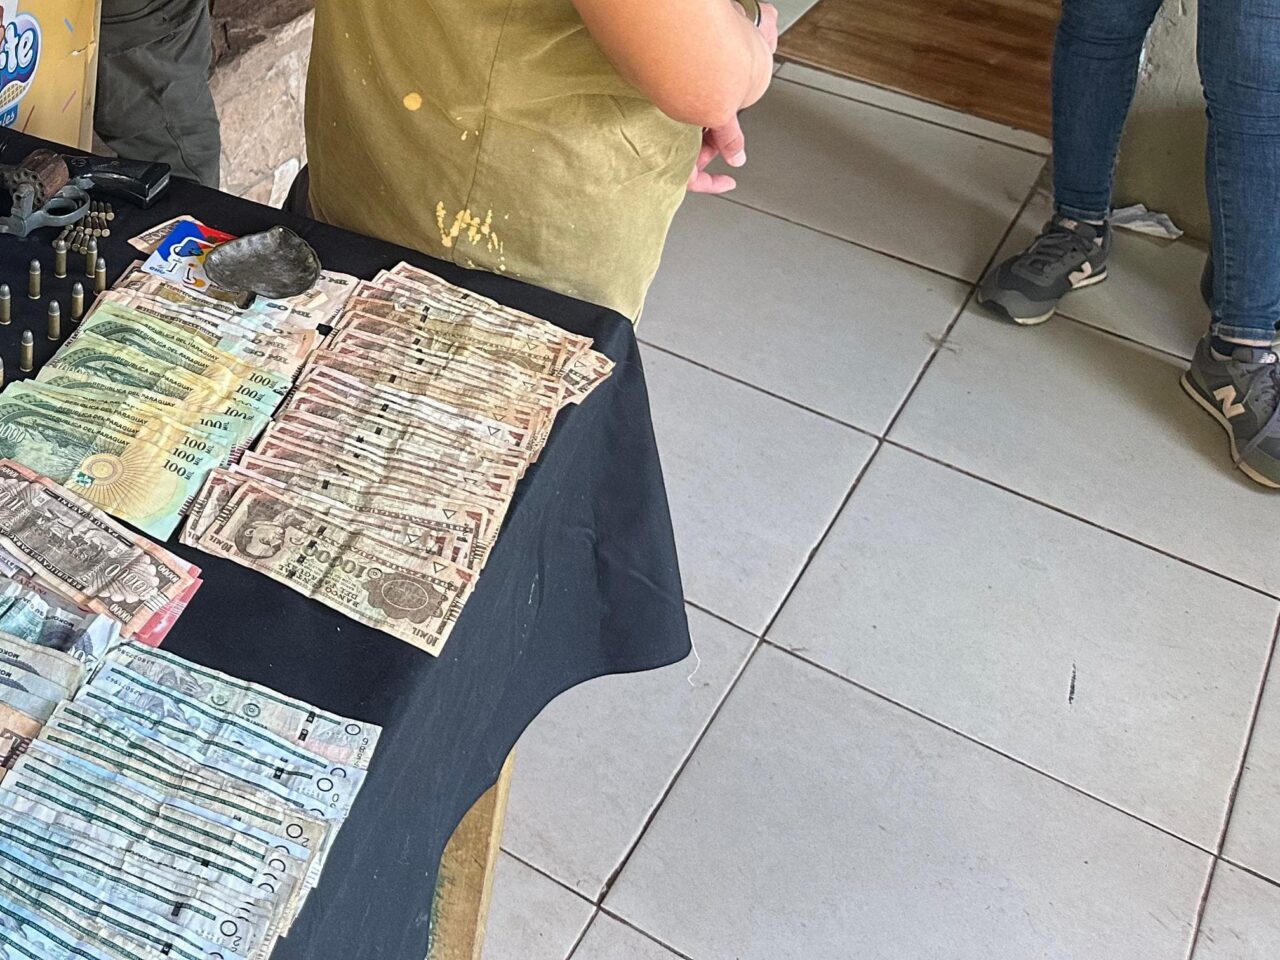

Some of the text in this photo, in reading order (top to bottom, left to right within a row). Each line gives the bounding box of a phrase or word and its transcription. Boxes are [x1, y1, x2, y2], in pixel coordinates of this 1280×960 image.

[266, 302, 312, 319] 50 MIL
[243, 346, 290, 365] 50 MIL
[149, 369, 161, 379] DEL
[160, 373, 194, 392] PARAGUAY
[248, 372, 270, 388] 100
[128, 390, 140, 398] DEL
[141, 393, 176, 408] PARAGUAY
[235, 384, 258, 400] 100
[93, 414, 106, 423] DEL
[106, 417, 140, 435] PARAGUAY
[82, 426, 95, 435] DEL
[95, 430, 131, 447] PARAGUAY
[182, 435, 207, 452] 100
[172, 447, 195, 463] 100
[162, 459, 187, 477] 100
[57, 497, 94, 521] GUARANI
[95, 519, 107, 530] SU
[220, 541, 233, 554] 10
[42, 560, 83, 590] REPUBLICA
[157, 563, 180, 583] 10000
[324, 586, 360, 608] BANCO
[340, 586, 359, 600] DEL
[109, 602, 133, 622] 10000
[412, 626, 439, 648] 10 MIL
